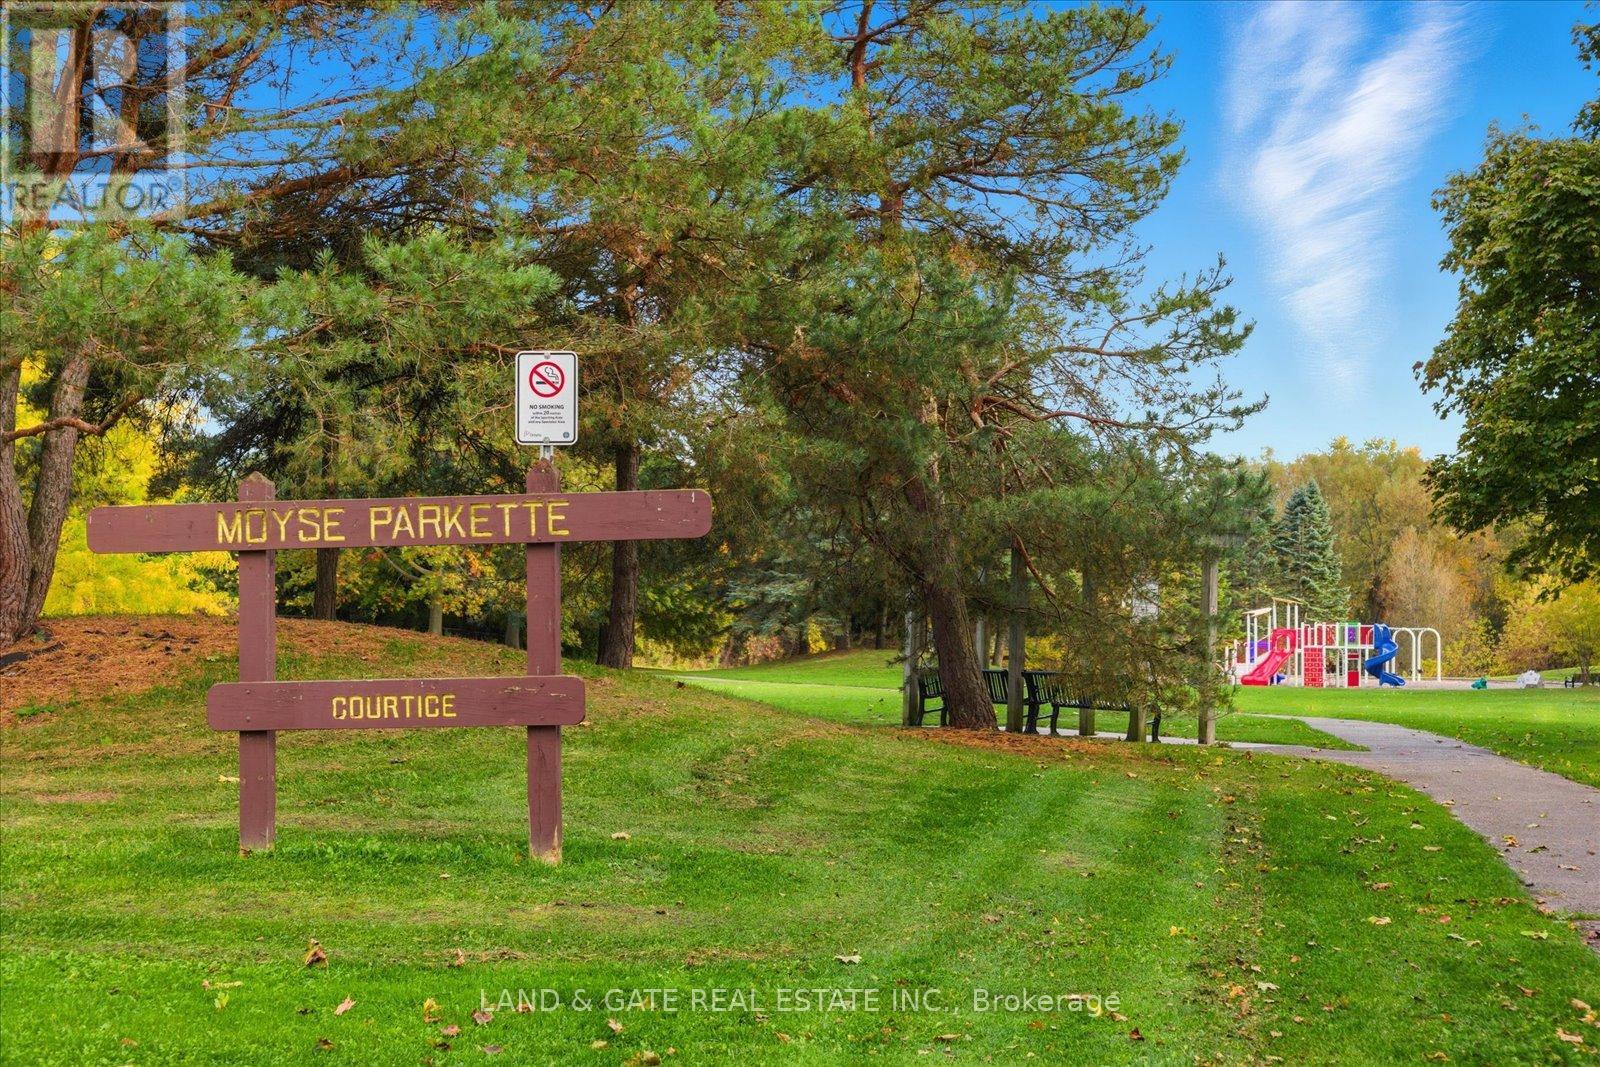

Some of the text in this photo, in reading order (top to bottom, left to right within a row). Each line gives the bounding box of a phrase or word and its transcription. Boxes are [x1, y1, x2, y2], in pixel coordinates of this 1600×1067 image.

[216, 502, 570, 544] MOYSE PARKETTE
[332, 695, 456, 720] COURTICE
